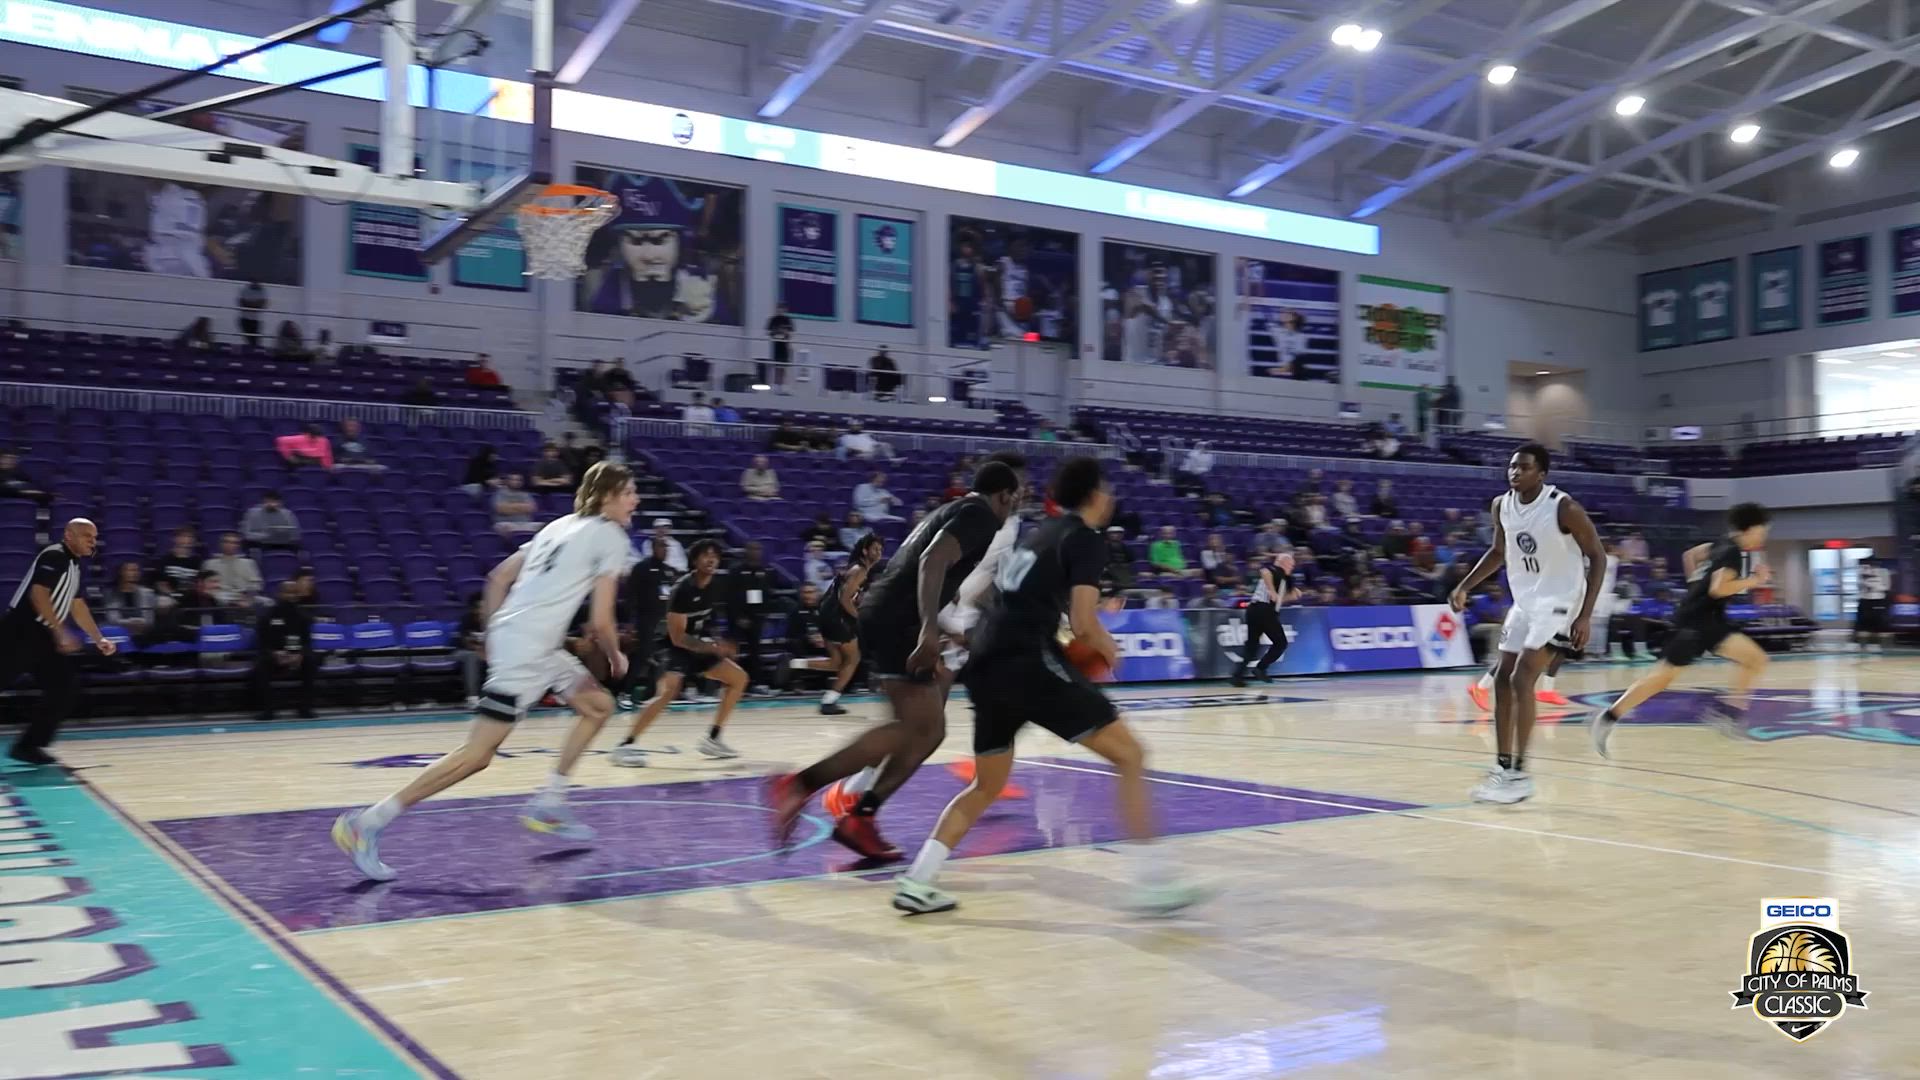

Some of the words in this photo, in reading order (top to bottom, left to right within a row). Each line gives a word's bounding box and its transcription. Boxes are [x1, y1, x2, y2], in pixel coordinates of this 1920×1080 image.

[1521, 556, 1540, 574] 10
[1111, 632, 1184, 658] EICO
[1330, 626, 1416, 651] GEICO
